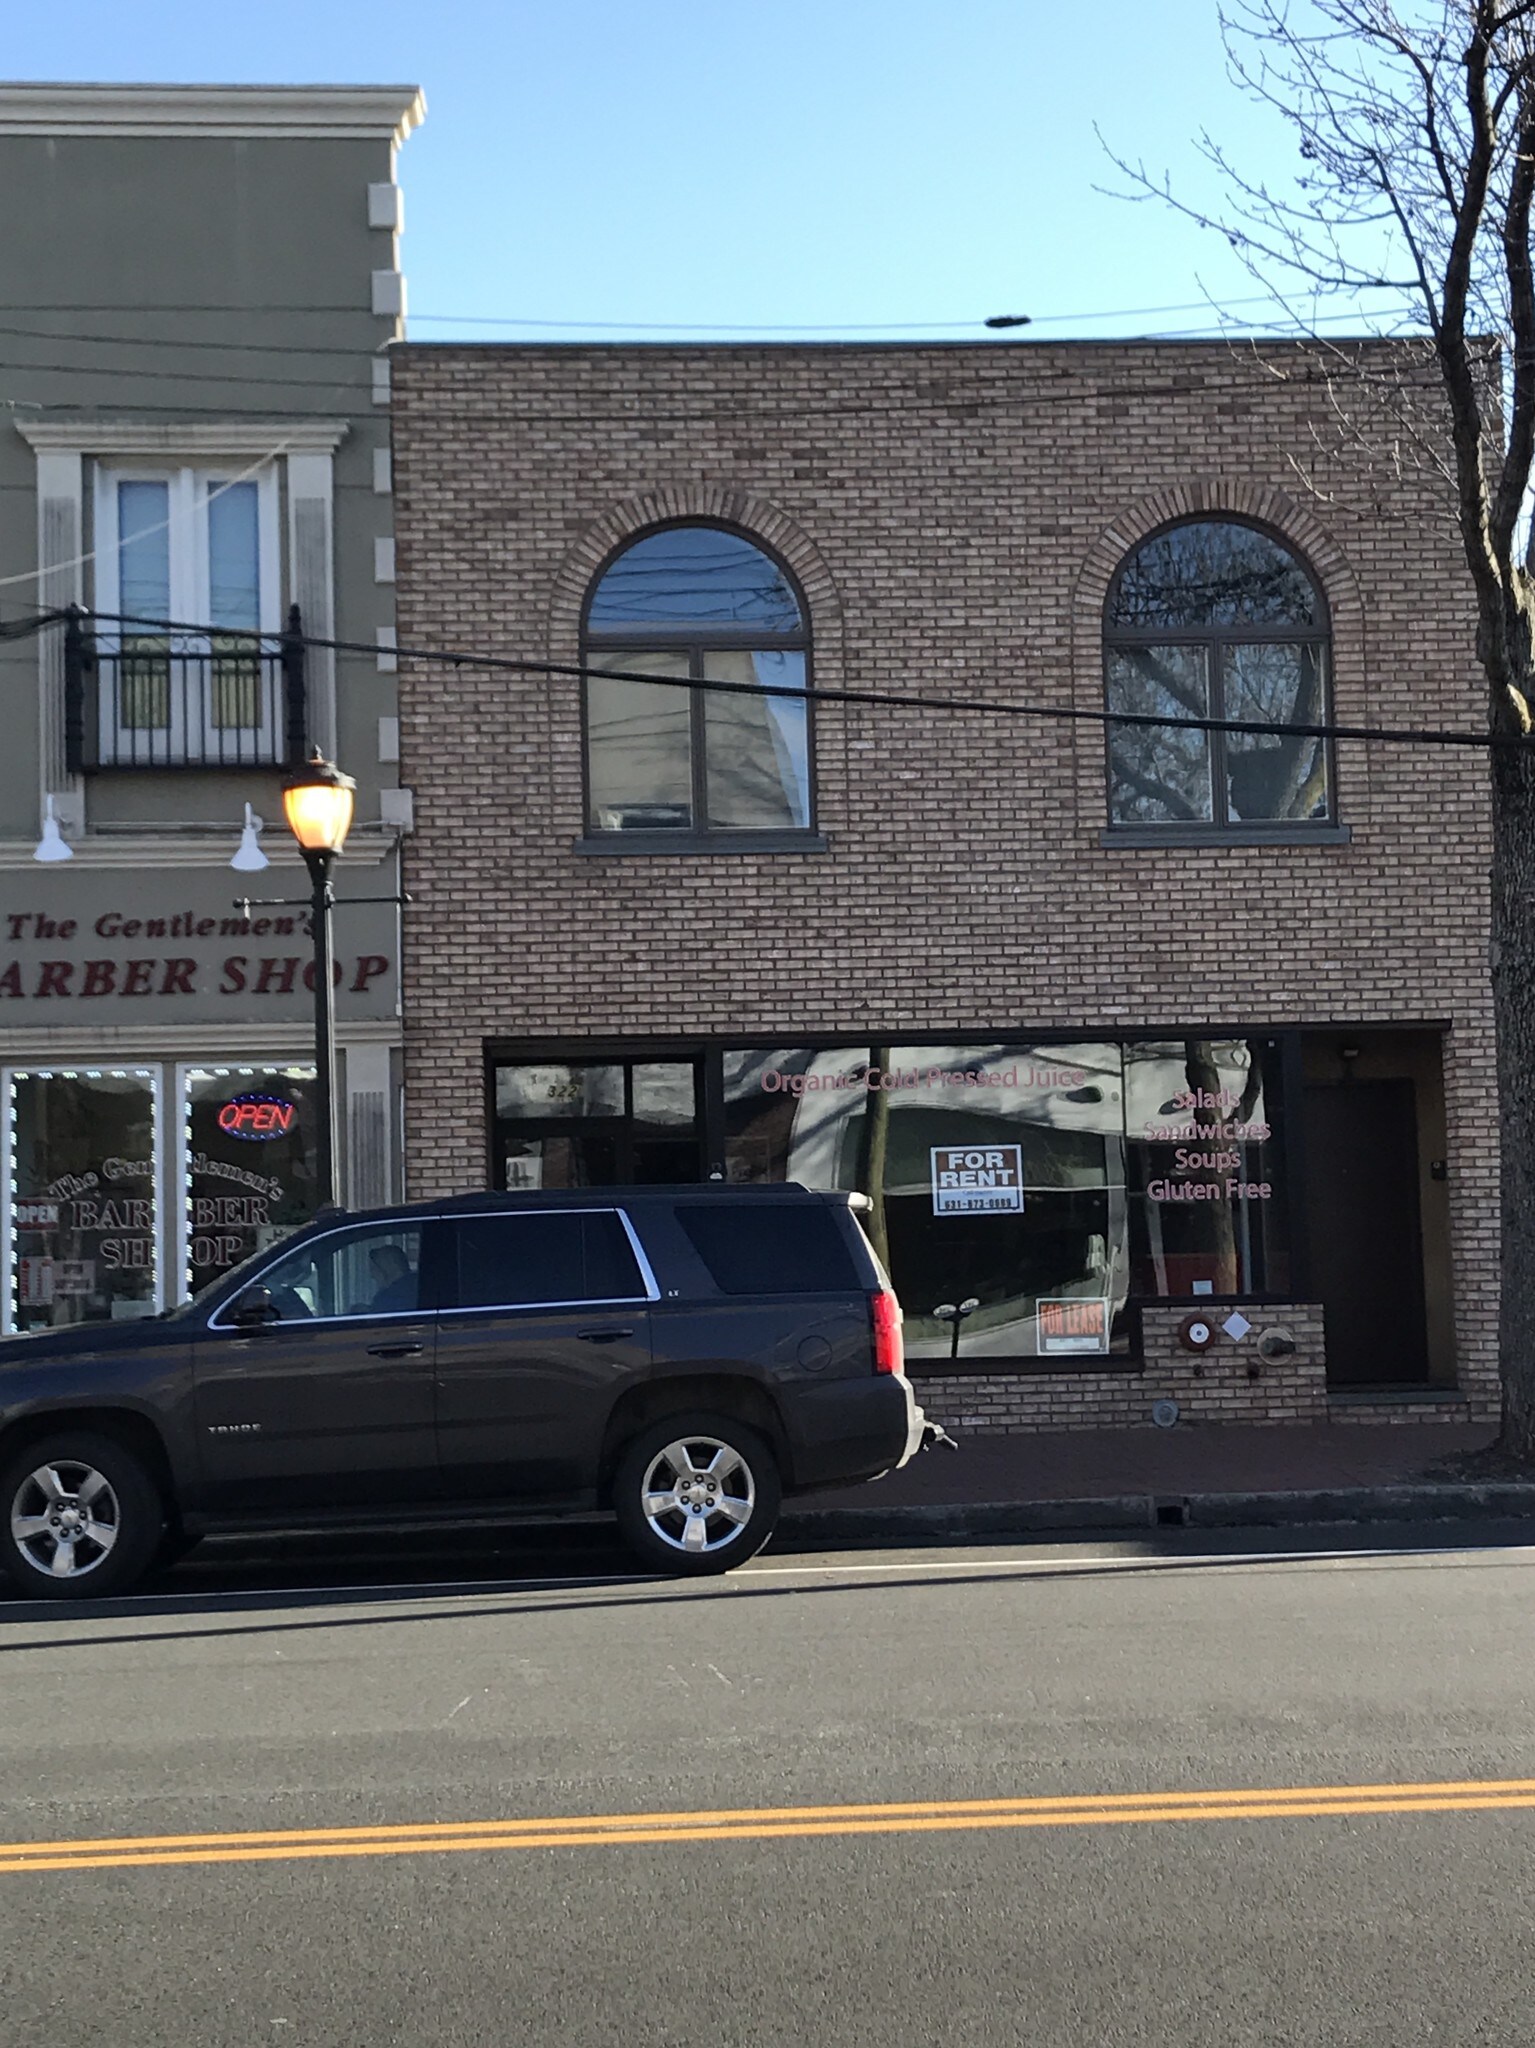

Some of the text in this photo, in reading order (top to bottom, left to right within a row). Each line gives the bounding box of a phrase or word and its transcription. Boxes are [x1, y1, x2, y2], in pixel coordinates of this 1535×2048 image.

[7, 912, 77, 940] The
[547, 1084, 578, 1099] 322
[760, 1065, 1086, 1098] Organic Cold Pressed Juice
[1172, 1087, 1241, 1109] Salads
[217, 1103, 293, 1130] OPEN
[1144, 1117, 1272, 1141] Sandwiches
[948, 1151, 1005, 1170] FOR
[1174, 1148, 1242, 1174] Soups
[48, 1171, 99, 1201] The
[940, 1168, 1015, 1188] RENT
[1146, 1178, 1273, 1201] Gluten Free
[17, 1204, 59, 1224] OPEN
[1040, 1302, 1104, 1335] FOR LEASE
